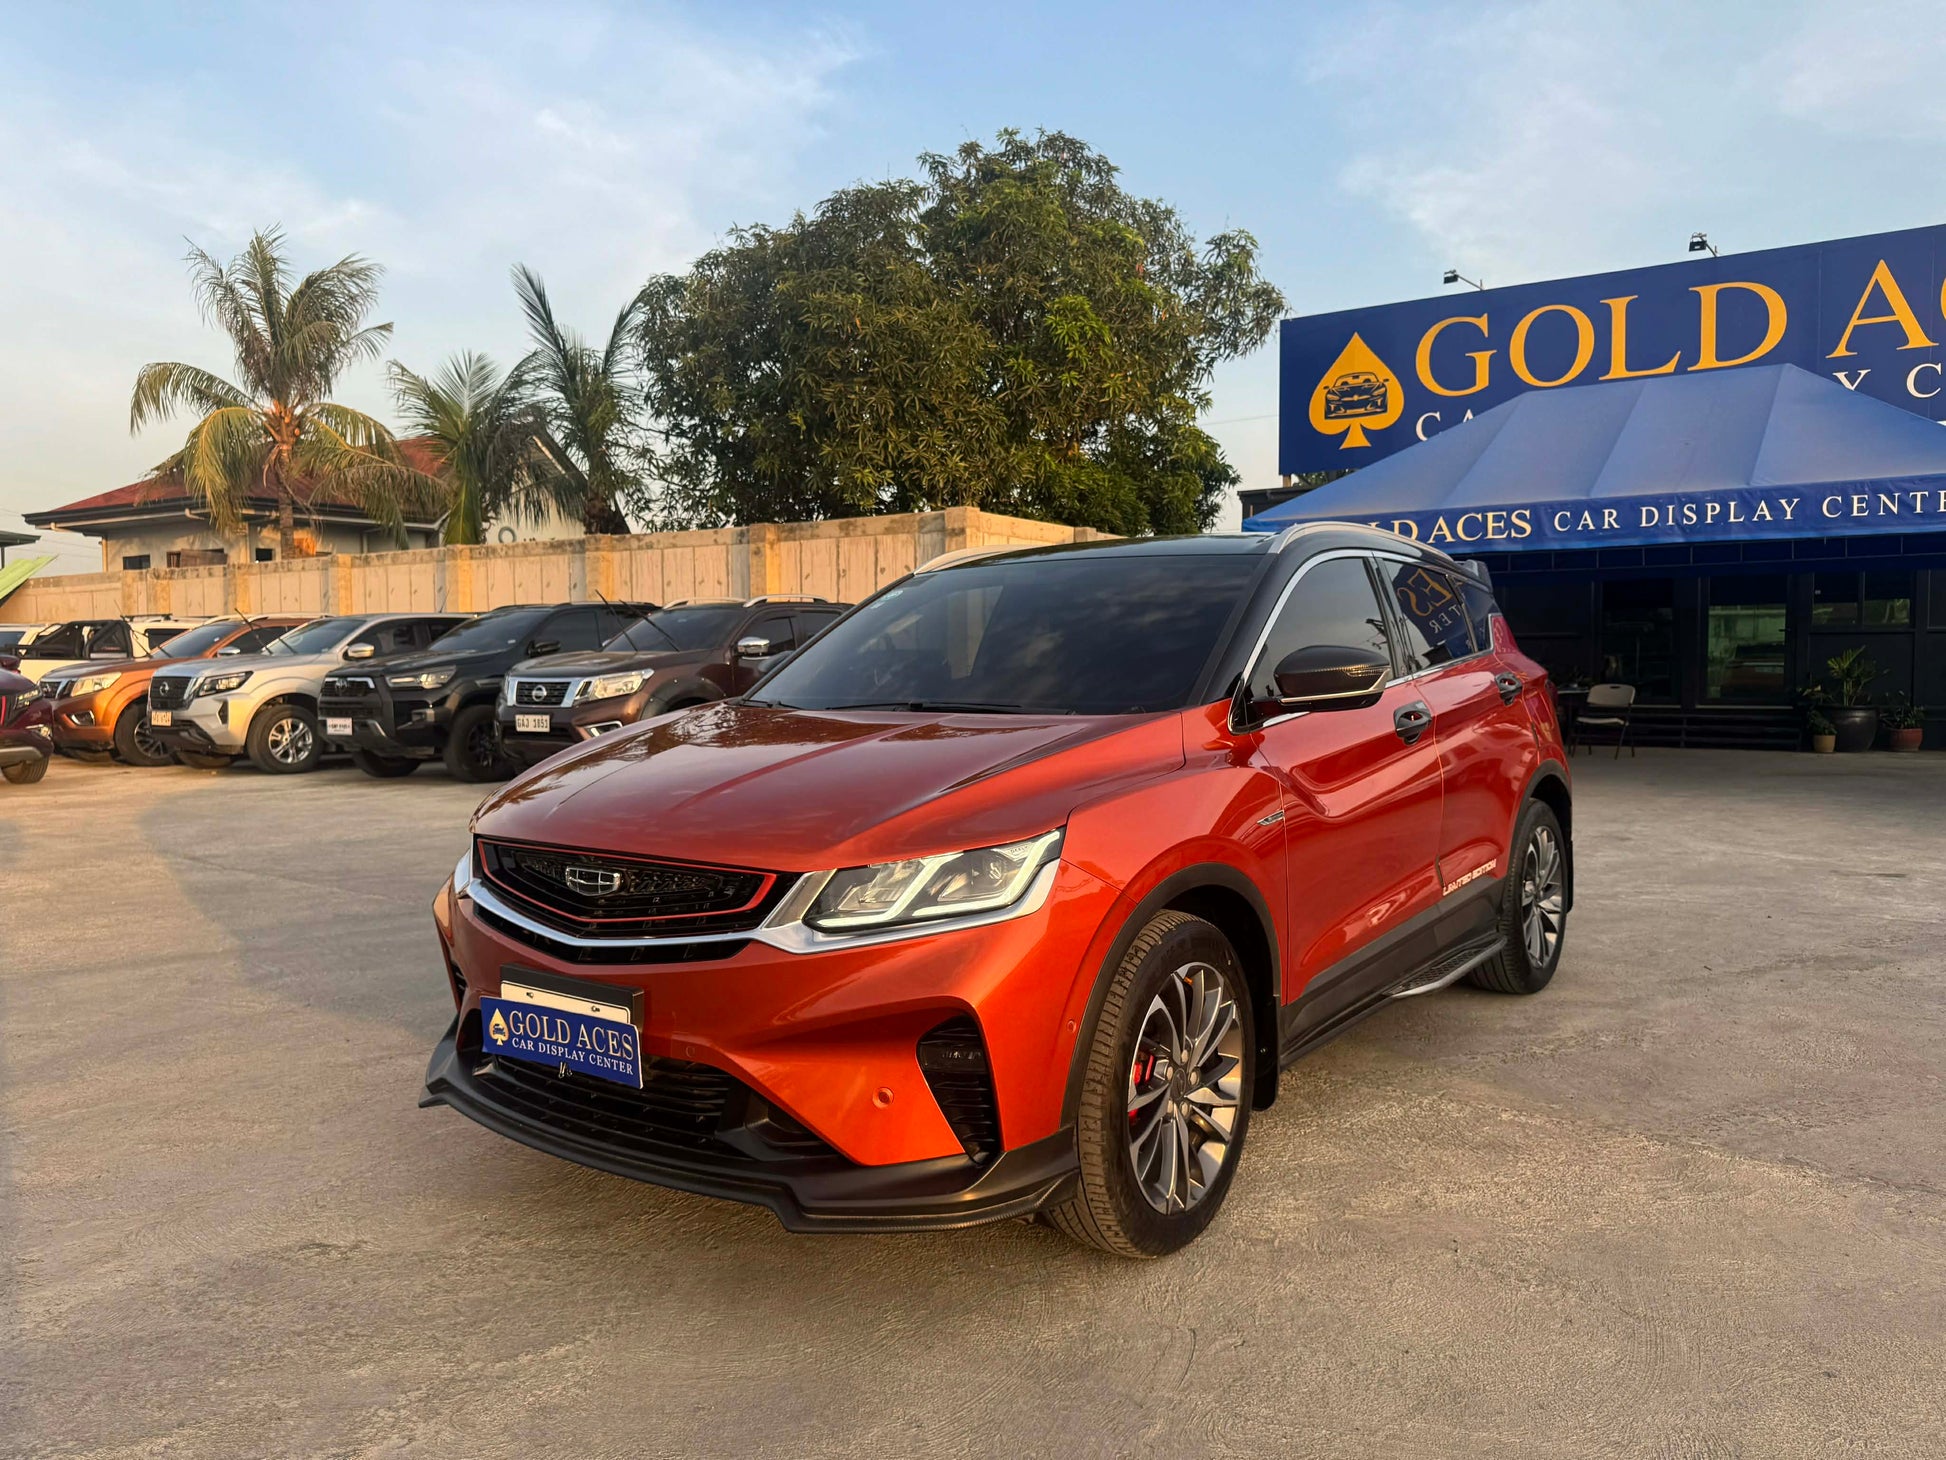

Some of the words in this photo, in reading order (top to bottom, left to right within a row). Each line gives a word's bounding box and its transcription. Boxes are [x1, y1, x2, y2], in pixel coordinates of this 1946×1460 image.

[1415, 282, 1788, 397] GOLD
[1427, 509, 1532, 544] ACES
[1553, 508, 1621, 532] CAR
[1639, 497, 1801, 527] DISPLAY
[509, 1010, 571, 1044] GOLD
[576, 1023, 634, 1060] ACES
[512, 1038, 535, 1051] CAR
[538, 1042, 586, 1062] DISPLAY
[589, 1053, 634, 1075] CENTER
